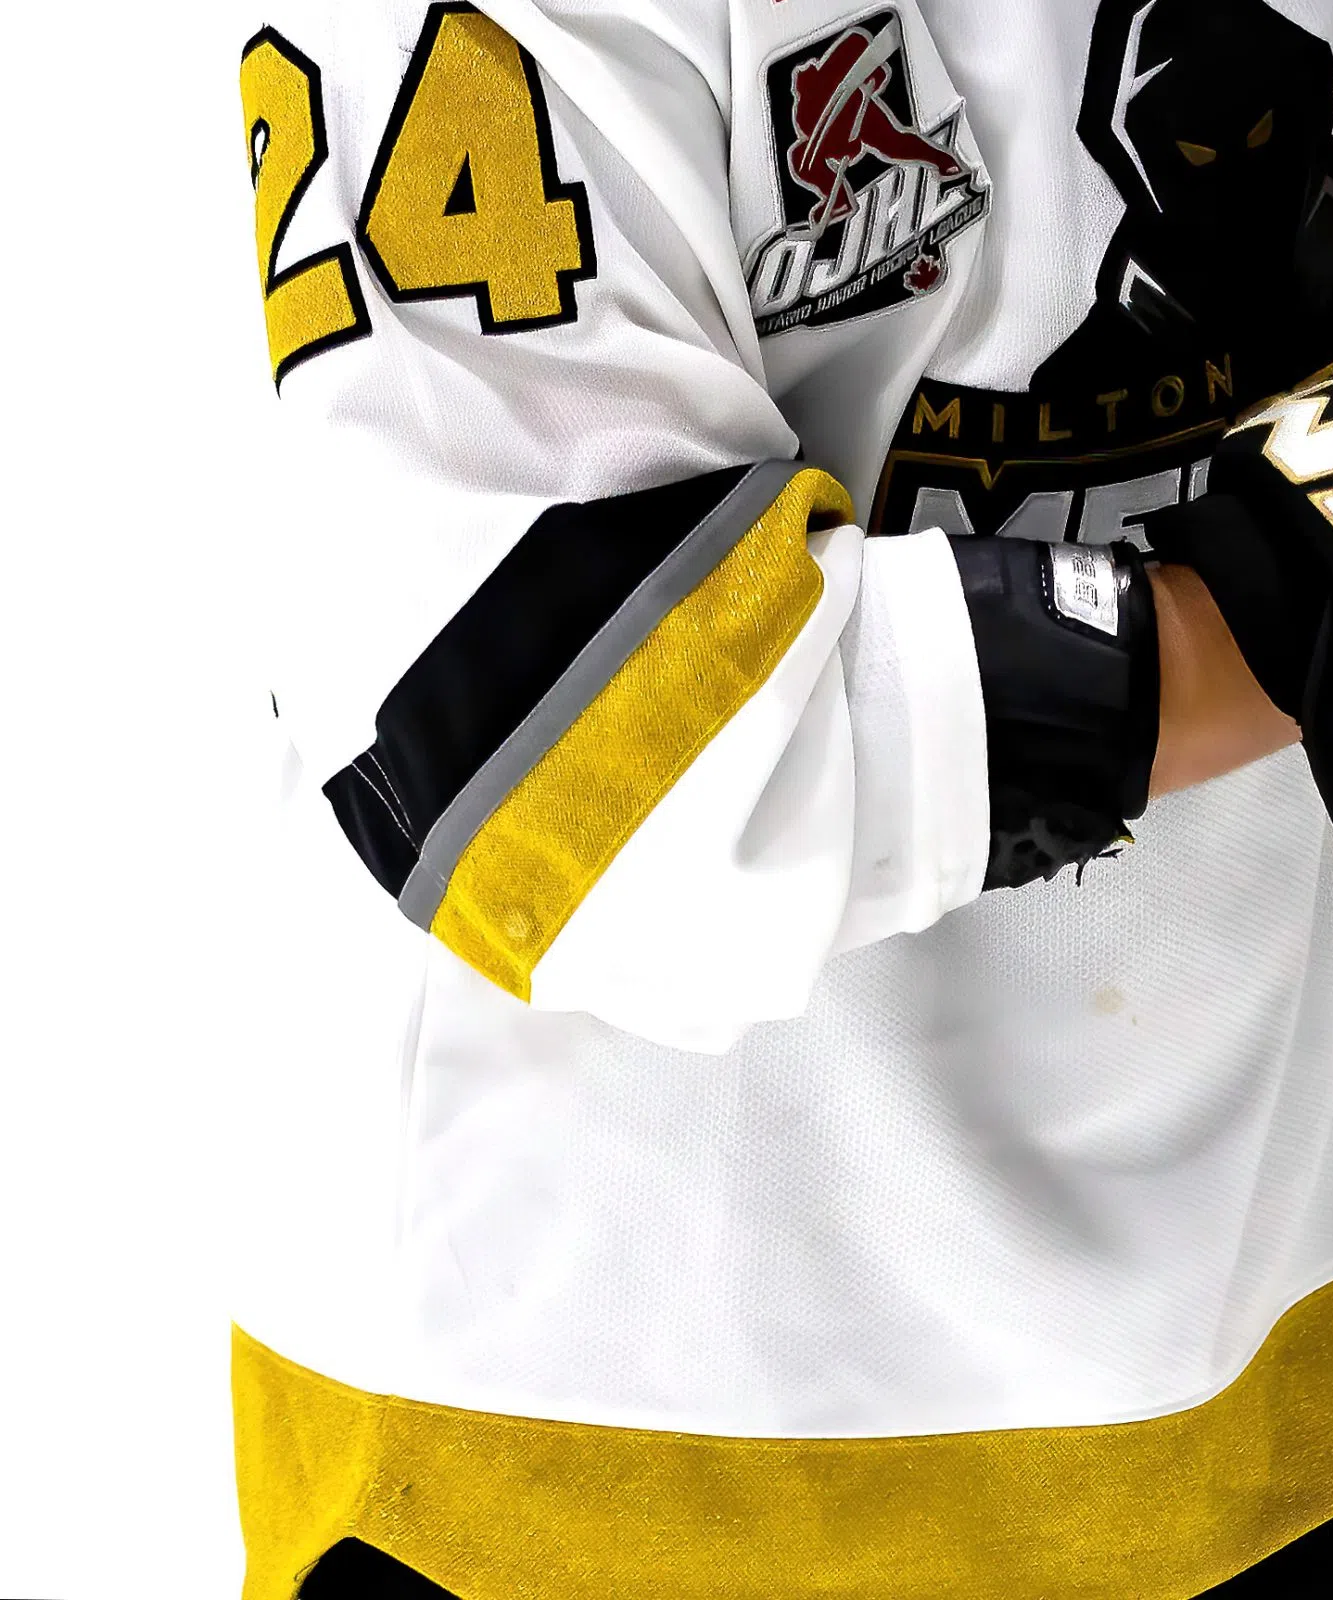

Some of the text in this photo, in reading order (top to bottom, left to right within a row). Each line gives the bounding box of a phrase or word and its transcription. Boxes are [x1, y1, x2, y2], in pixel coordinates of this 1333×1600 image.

[240, 0, 598, 400] 24
[752, 165, 972, 318] OJHL
[911, 353, 1233, 442] MILTON
